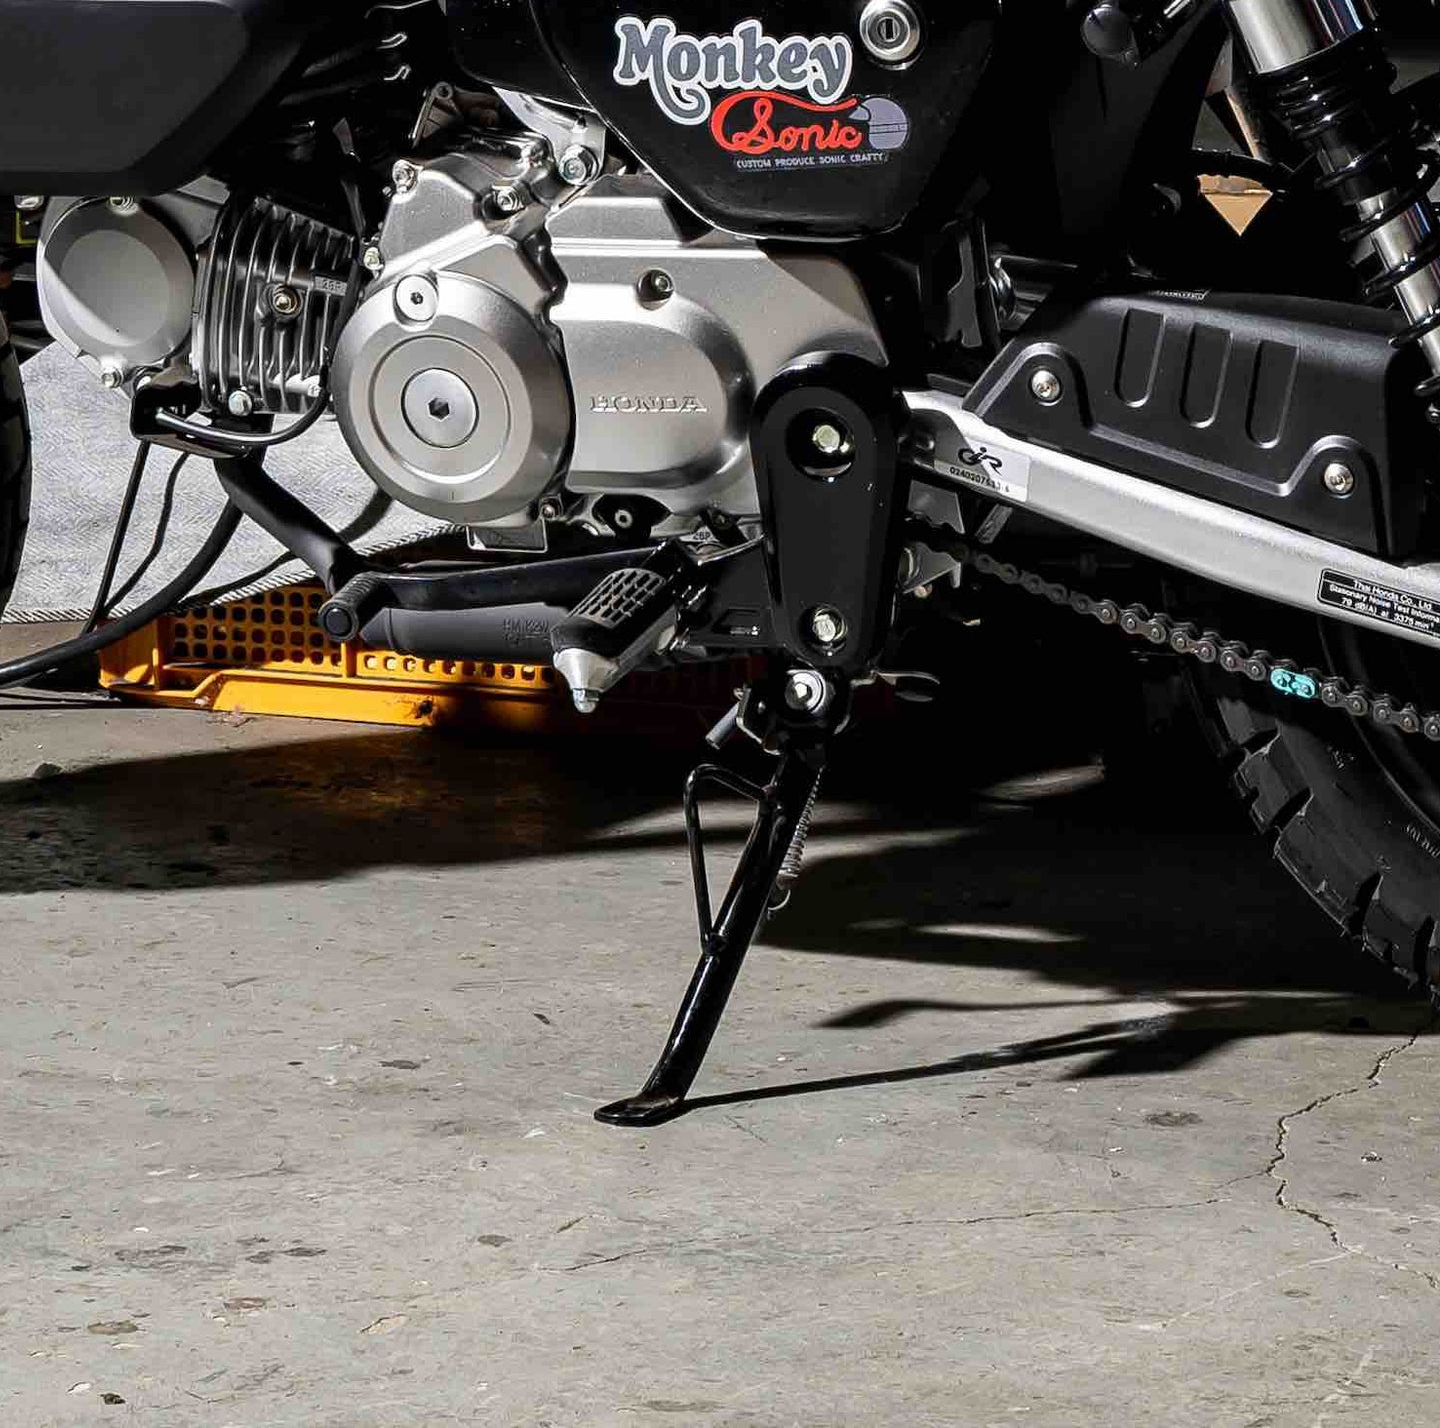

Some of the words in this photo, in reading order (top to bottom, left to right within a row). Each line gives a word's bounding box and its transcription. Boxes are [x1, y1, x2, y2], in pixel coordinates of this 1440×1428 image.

[612, 15, 853, 126] Monkey
[709, 89, 865, 155] Sonic
[736, 158, 772, 170] CUSTOM
[774, 155, 815, 167] PRODUCE
[818, 153, 847, 165] SONIC
[590, 395, 708, 413] HONDA
[1329, 584, 1367, 602] Stationary
[1393, 601, 1410, 613] Test
[1353, 579, 1372, 592] Thai
[1372, 586, 1399, 602] Honda
